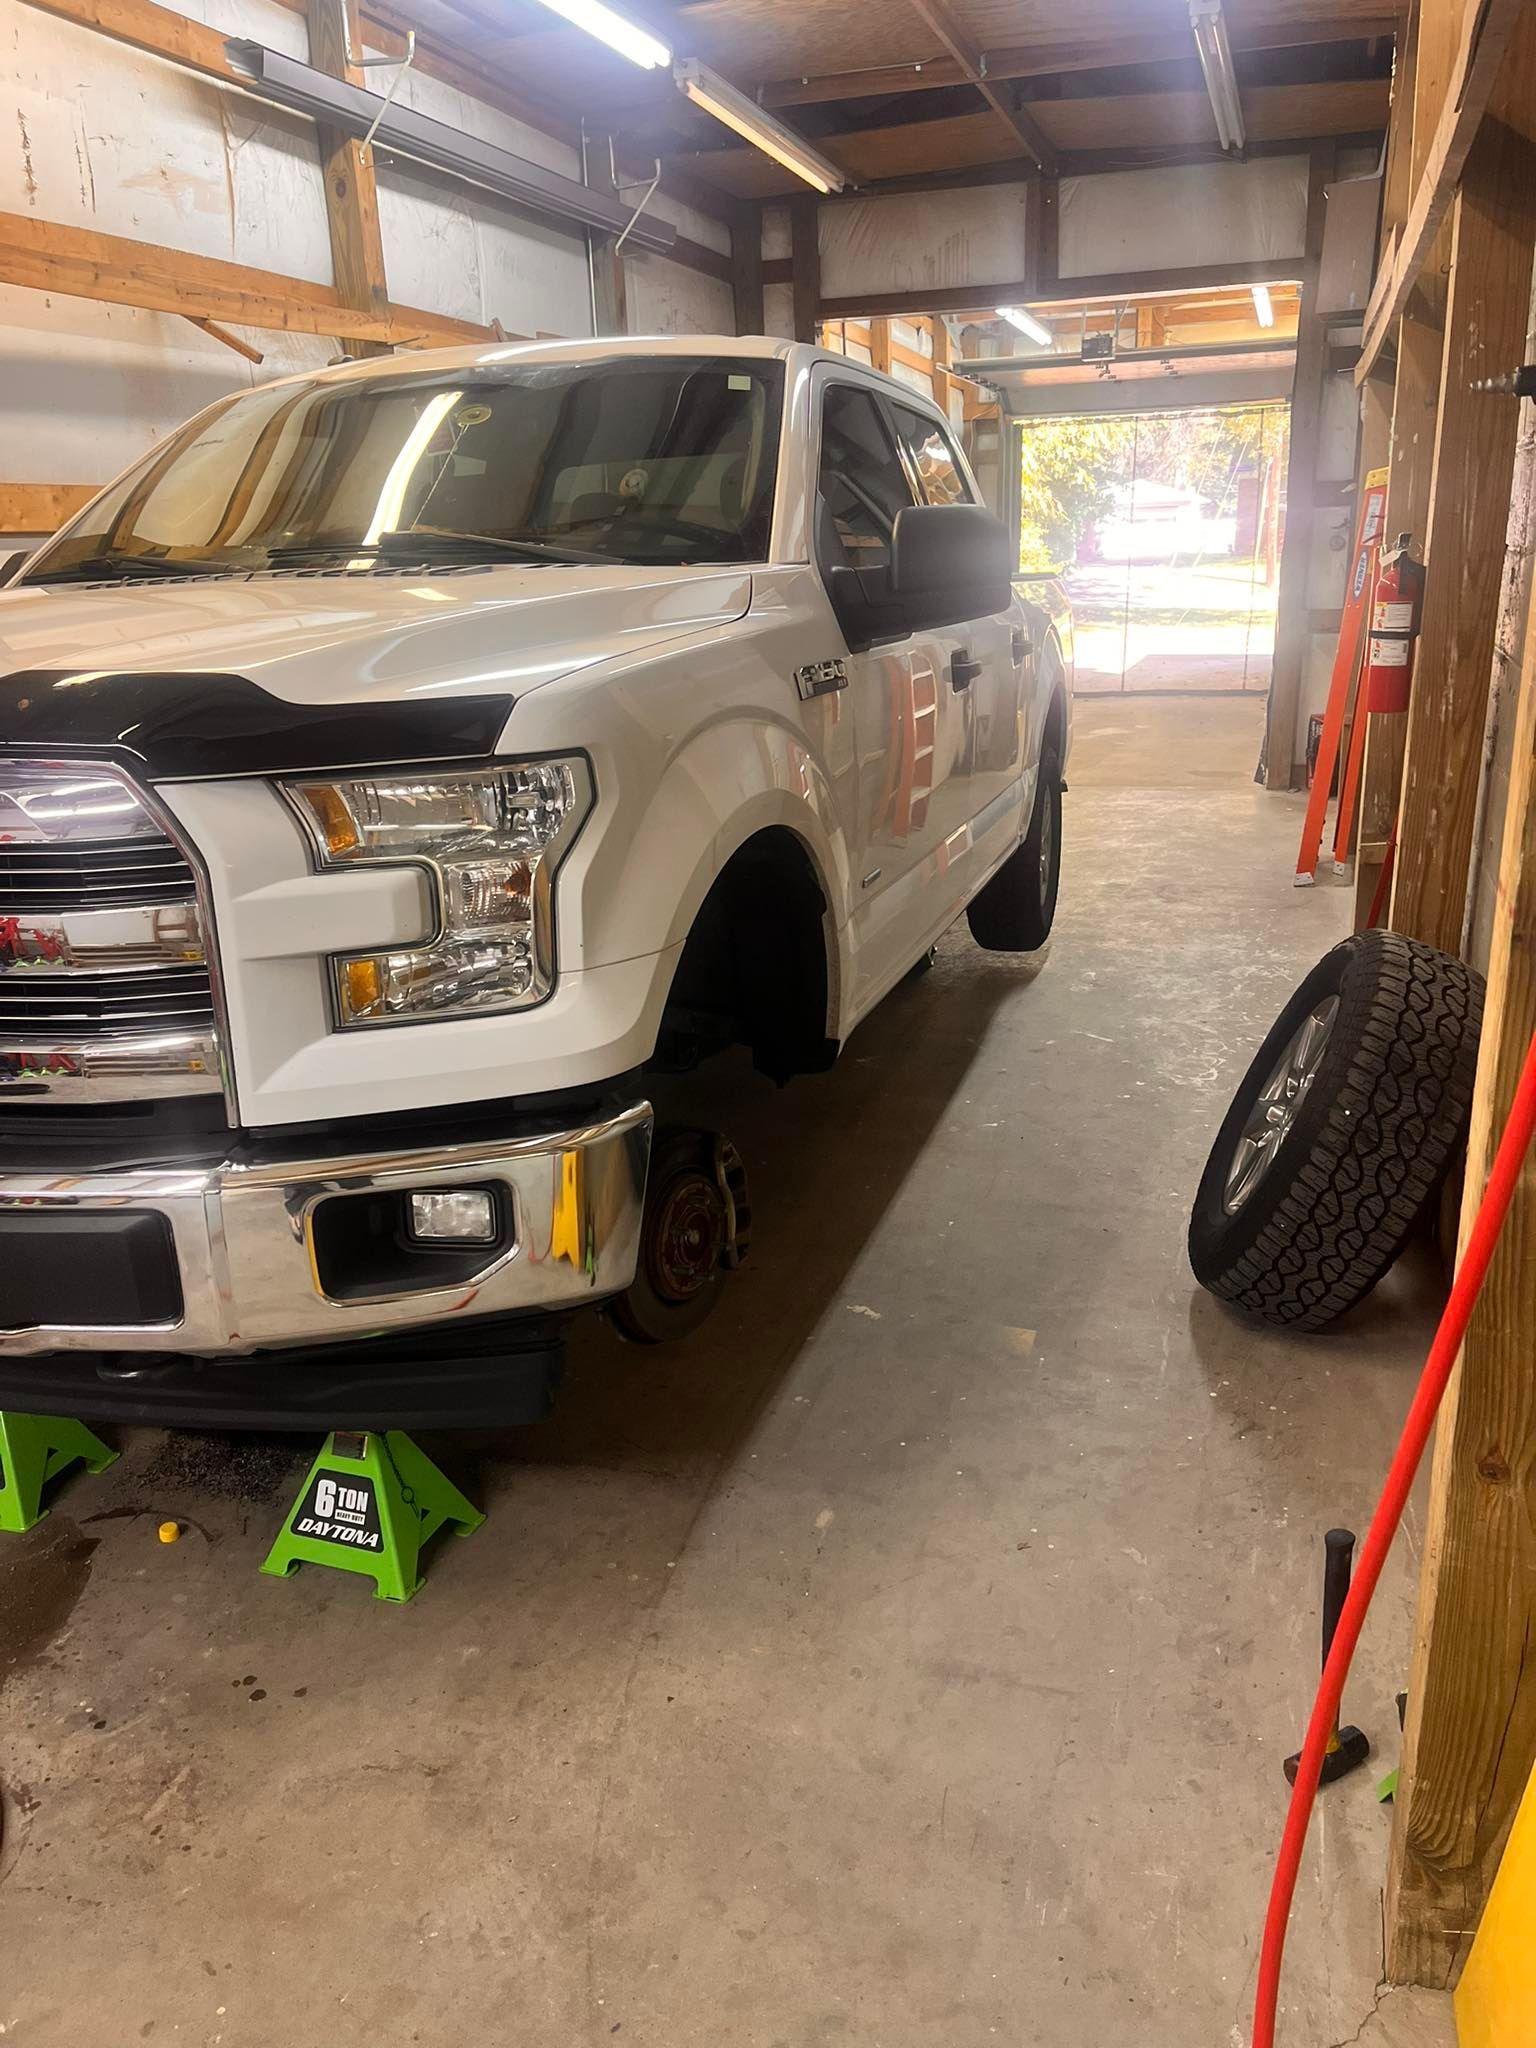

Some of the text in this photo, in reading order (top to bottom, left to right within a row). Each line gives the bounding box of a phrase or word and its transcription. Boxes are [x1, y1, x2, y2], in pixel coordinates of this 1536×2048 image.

[314, 1478, 369, 1518] 6 TON
[336, 1510, 364, 1523] HEAVY DUTY
[297, 1518, 379, 1548] DAYTONA
